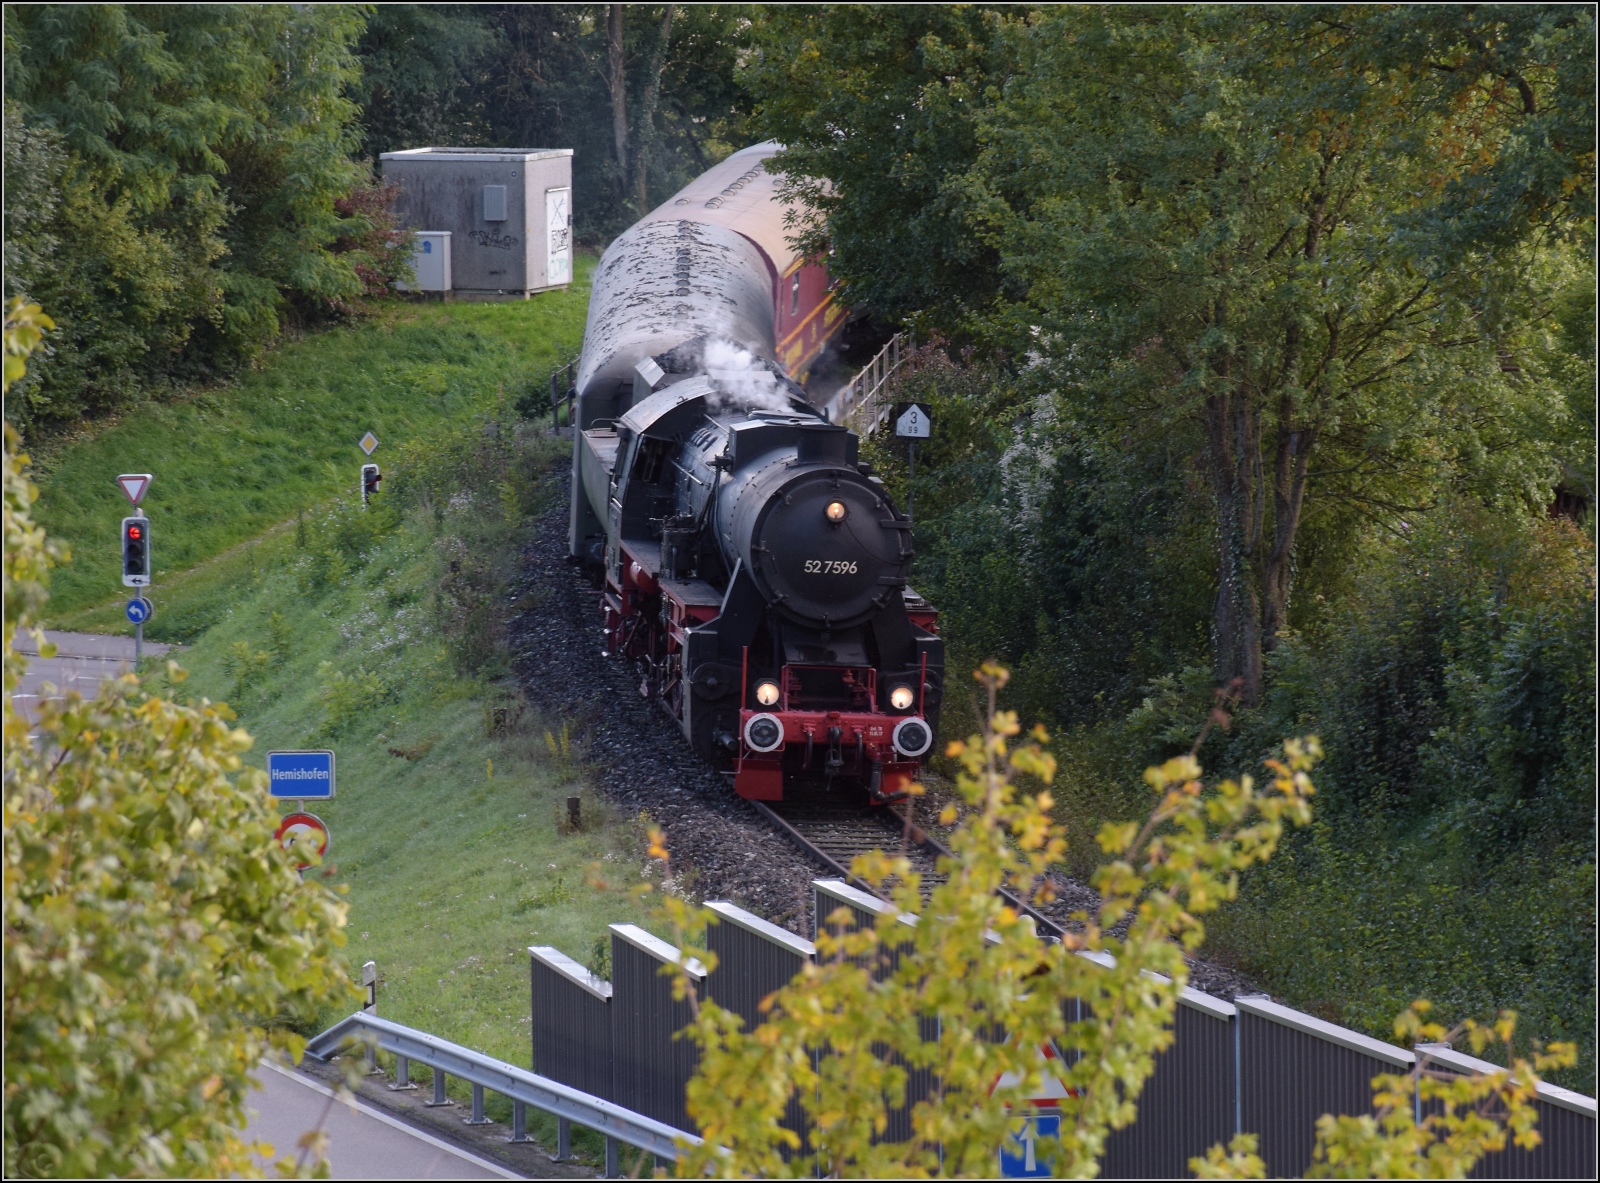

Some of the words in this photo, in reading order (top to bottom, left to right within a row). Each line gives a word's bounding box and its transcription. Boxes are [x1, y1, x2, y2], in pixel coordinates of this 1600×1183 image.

[910, 411, 918, 424] 3
[804, 560, 822, 573] 52
[824, 560, 858, 574] 7596
[271, 767, 329, 780] Hemishofen
